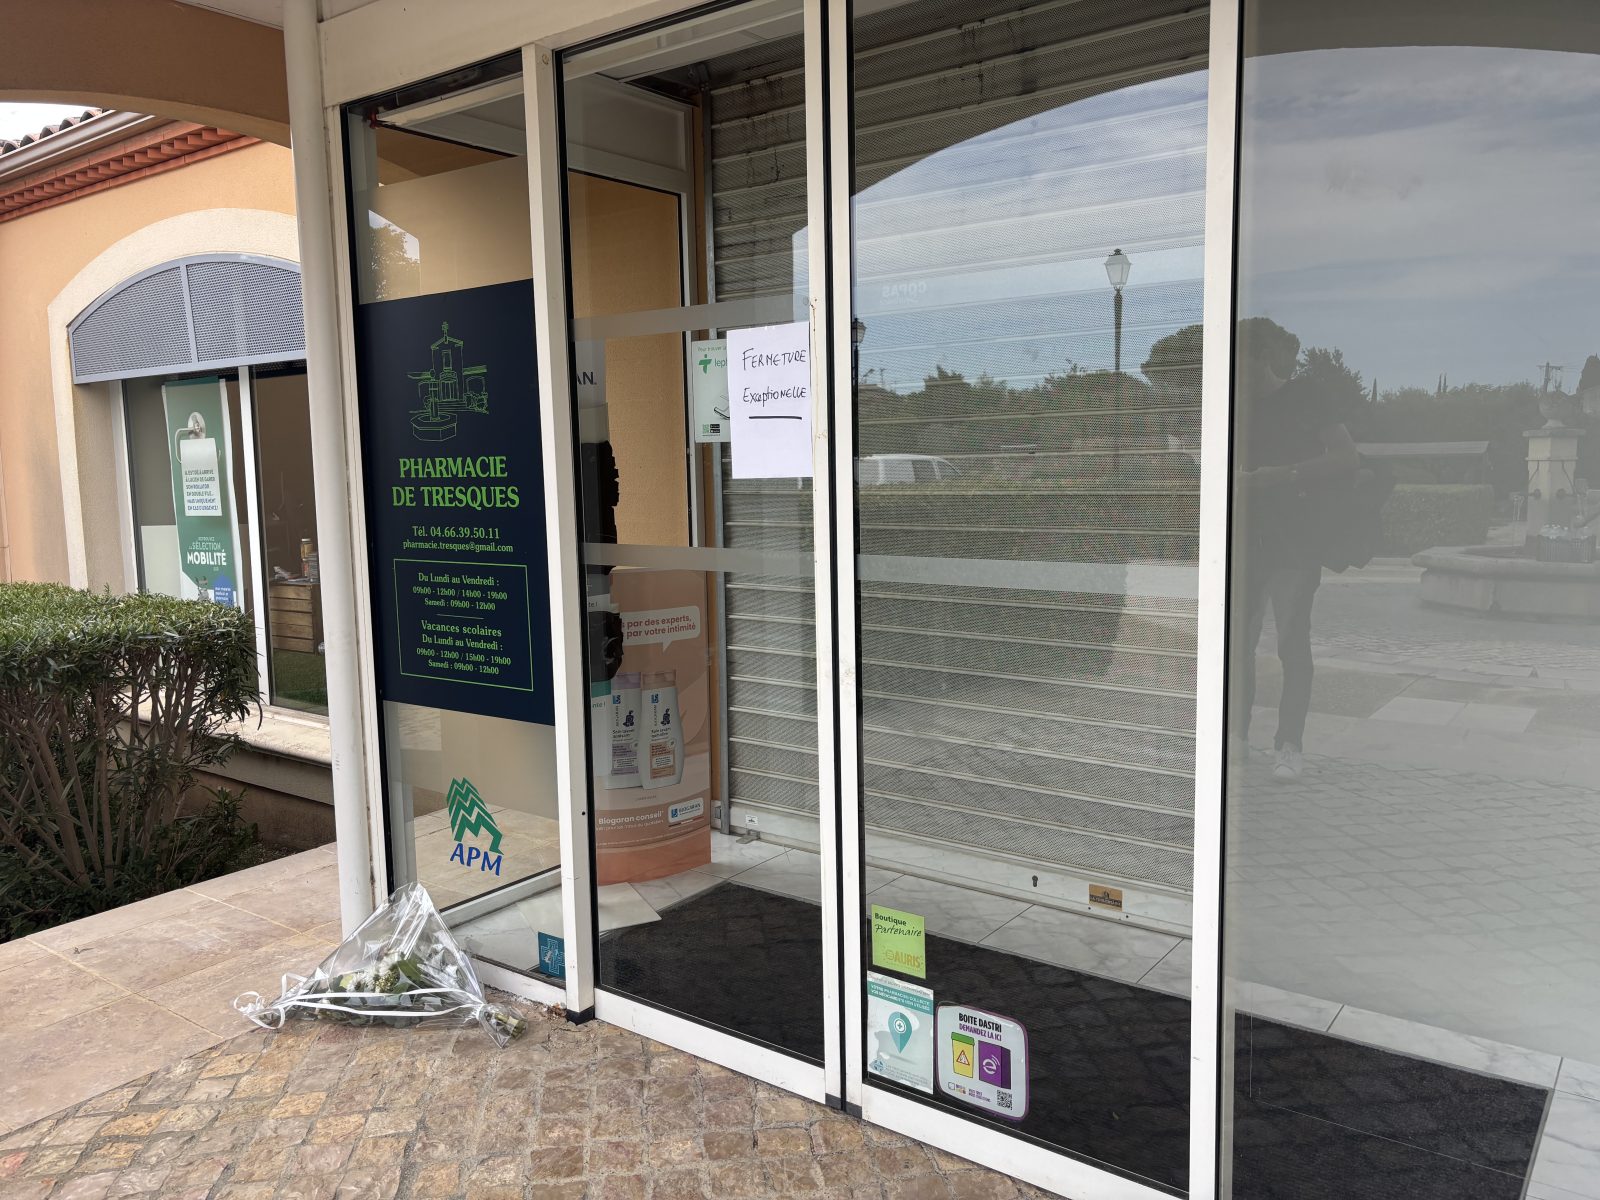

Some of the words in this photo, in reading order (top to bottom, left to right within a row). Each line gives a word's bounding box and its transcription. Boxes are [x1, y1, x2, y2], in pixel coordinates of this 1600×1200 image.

[742, 348, 806, 370] FERMETURE
[399, 456, 508, 478] PHARMACIE
[392, 486, 416, 506] DE
[420, 486, 520, 510] TRESQUES
[412, 526, 428, 537] Tél.
[430, 526, 499, 539] 04.66.39.50.11
[403, 540, 513, 552] pharmacie.tresques@gmail.com
[187, 549, 227, 566] MOBILITÉ
[418, 573, 428, 582] Du
[430, 573, 450, 583] Lundi
[462, 575, 495, 586] Vendredi
[413, 586, 431, 594] 09h00
[437, 588, 455, 596] 12h00
[462, 590, 481, 598] 14h00
[488, 591, 507, 600] 19h00
[425, 598, 445, 607] Samedi
[450, 600, 470, 608] 09h00
[476, 602, 495, 610] 12h00
[421, 620, 460, 633] Vacances
[463, 625, 502, 636] scolaires
[627, 620, 643, 629] par
[661, 615, 691, 625] experts,
[627, 630, 642, 639] par
[668, 622, 696, 633] intimité
[422, 634, 432, 643] Du
[434, 635, 453, 645] Lundi
[466, 639, 498, 650] Vendredi
[417, 648, 435, 657] 09h00
[440, 650, 459, 659] 12h00
[466, 653, 485, 662] 15h00
[491, 656, 511, 665] 19h00
[428, 660, 449, 669] Samedi
[454, 663, 473, 671] 09h00
[479, 665, 499, 674] 12h00
[599, 814, 635, 826] Biogaran
[450, 843, 502, 876] APM
[874, 912, 907, 926] Boutique
[874, 923, 922, 938] Partenaire
[894, 951, 921, 968] AURIS
[959, 1013, 977, 1025] BOITE
[979, 1019, 1001, 1032] DASTRI
[959, 1023, 987, 1037] DEMANDEZ
[988, 1031, 994, 1039] LA
